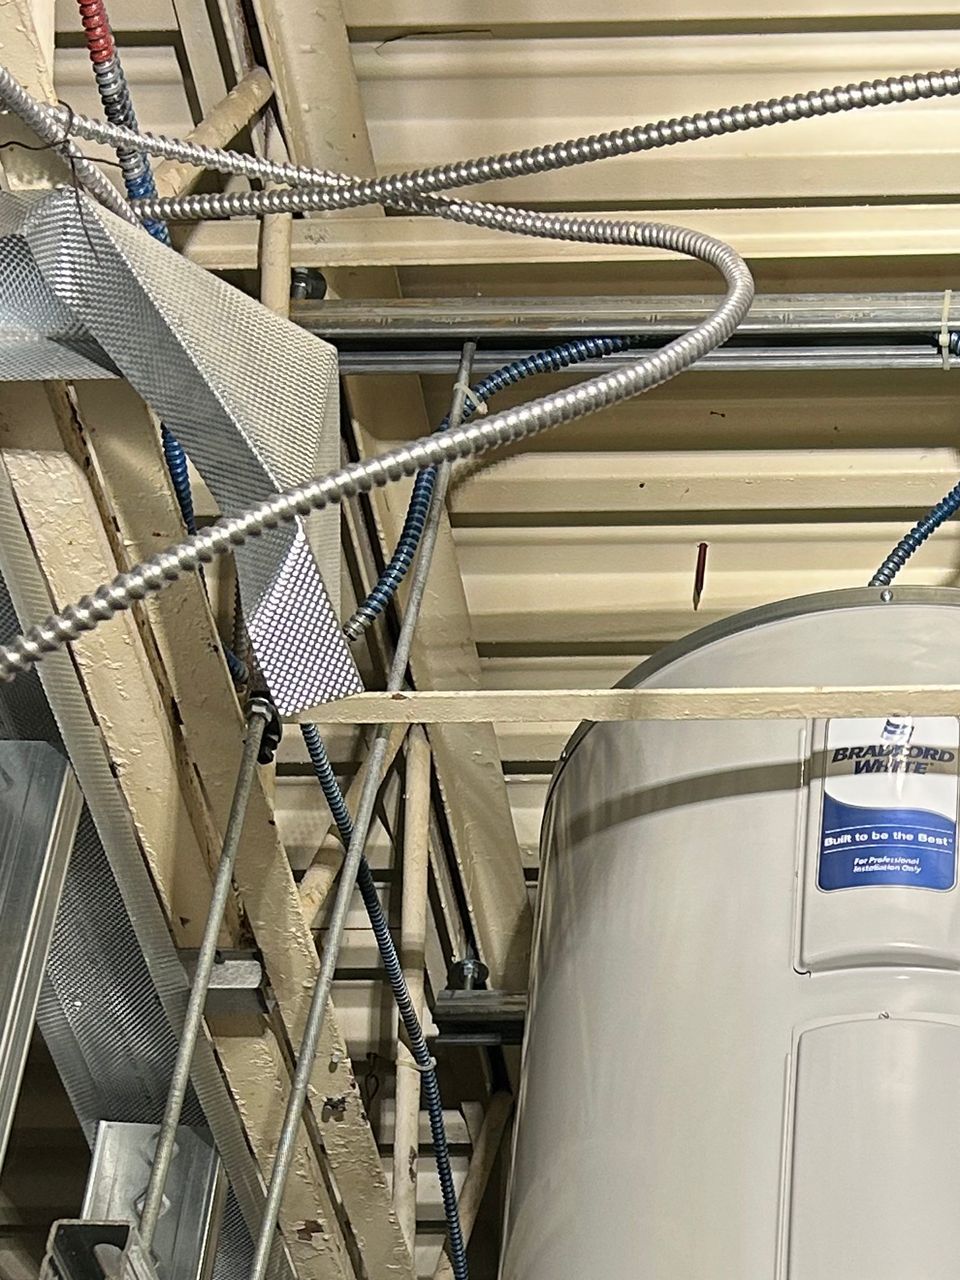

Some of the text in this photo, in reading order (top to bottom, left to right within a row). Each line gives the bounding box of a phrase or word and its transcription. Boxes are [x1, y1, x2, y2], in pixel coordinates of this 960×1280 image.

[824, 834, 852, 847] Built
[855, 832, 869, 842] to
[872, 831, 889, 841] be
[893, 831, 914, 841] the
[854, 857, 869, 865] For
